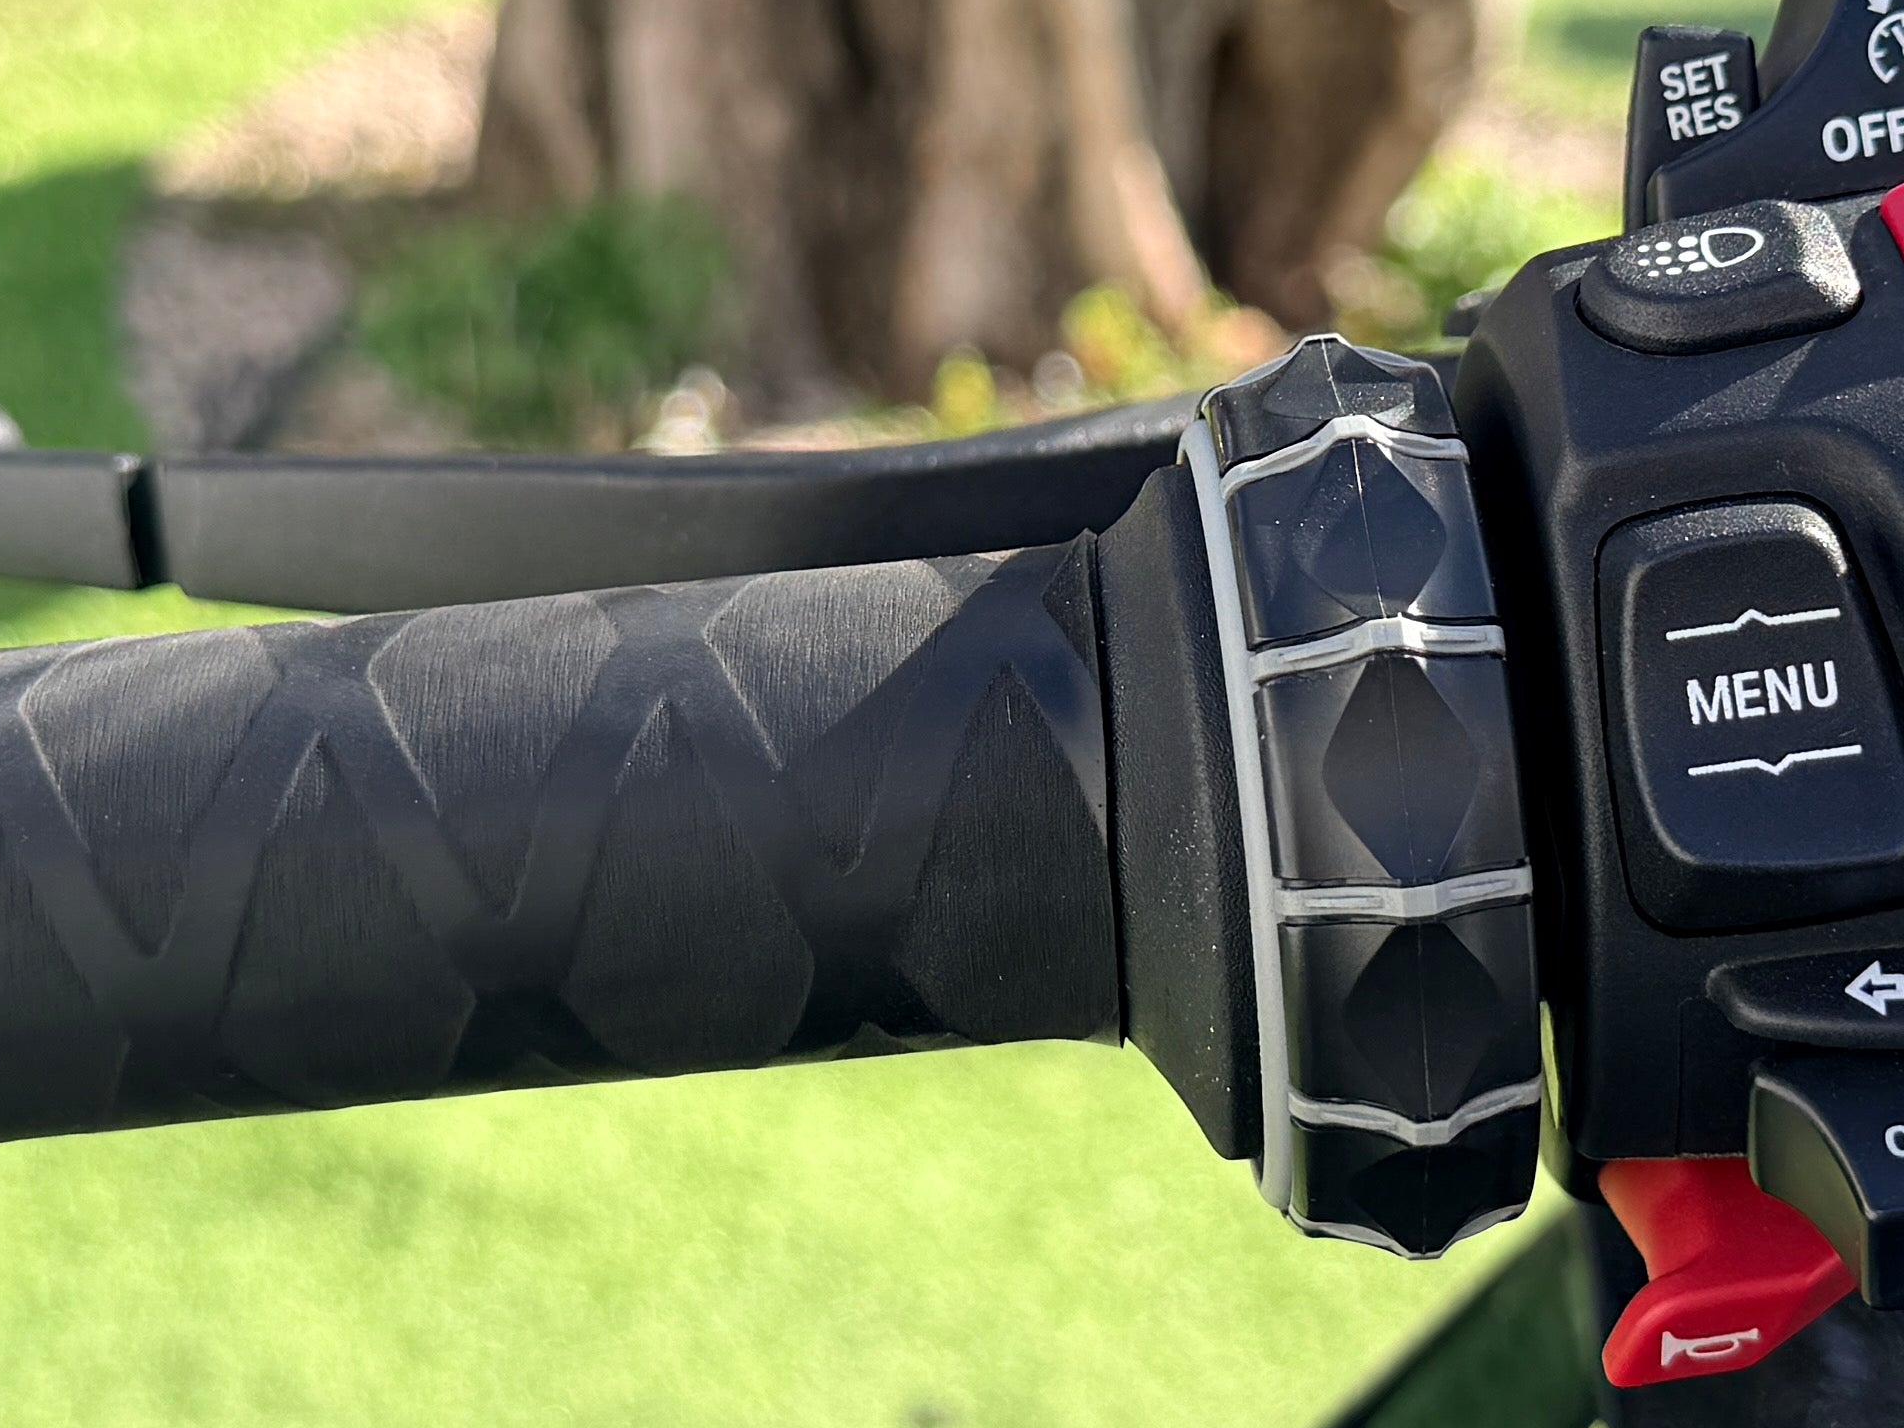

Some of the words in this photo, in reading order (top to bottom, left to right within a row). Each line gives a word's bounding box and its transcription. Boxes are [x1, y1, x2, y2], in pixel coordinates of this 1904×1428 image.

[1660, 54, 1729, 101] SET
[1666, 93, 1741, 141] RES
[1686, 660, 1839, 726] MENU
